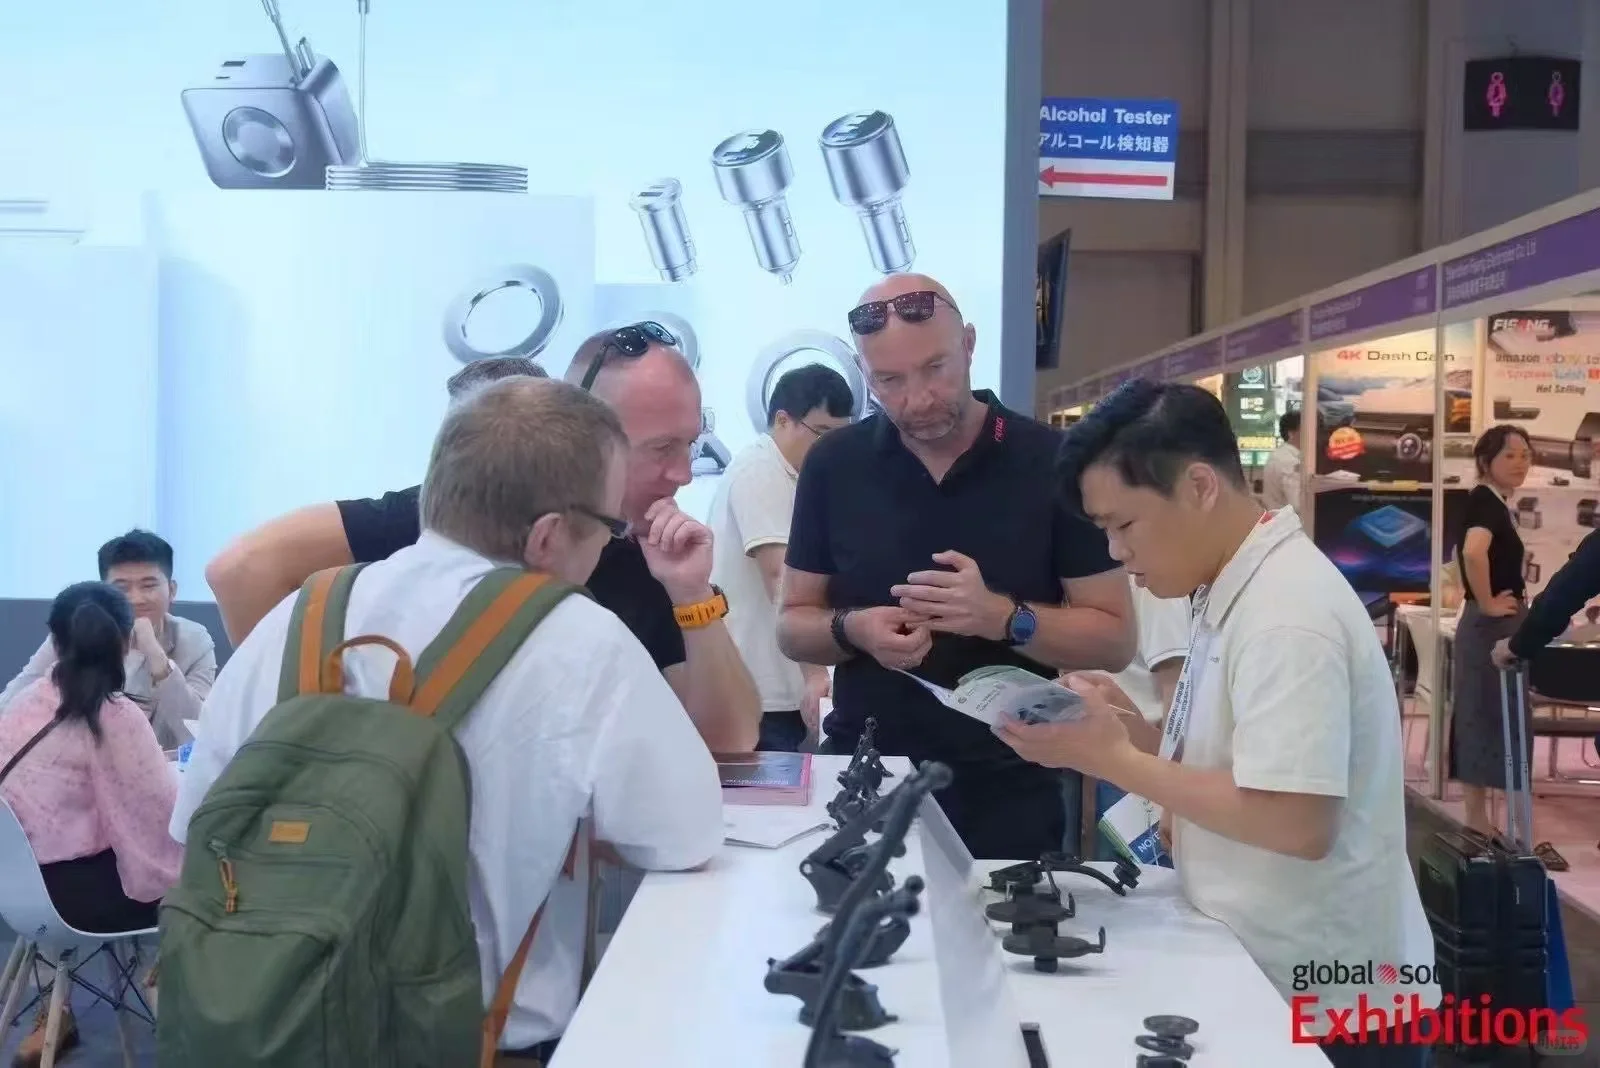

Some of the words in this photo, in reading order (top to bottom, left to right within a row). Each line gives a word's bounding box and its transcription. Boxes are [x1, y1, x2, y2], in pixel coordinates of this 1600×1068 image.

[1040, 106, 1106, 123] Alcohol
[1113, 108, 1171, 125] Tester
[1039, 132, 1169, 153] アルコール検知器
[1337, 350, 1362, 361] 4K
[1367, 350, 1411, 361] Dash
